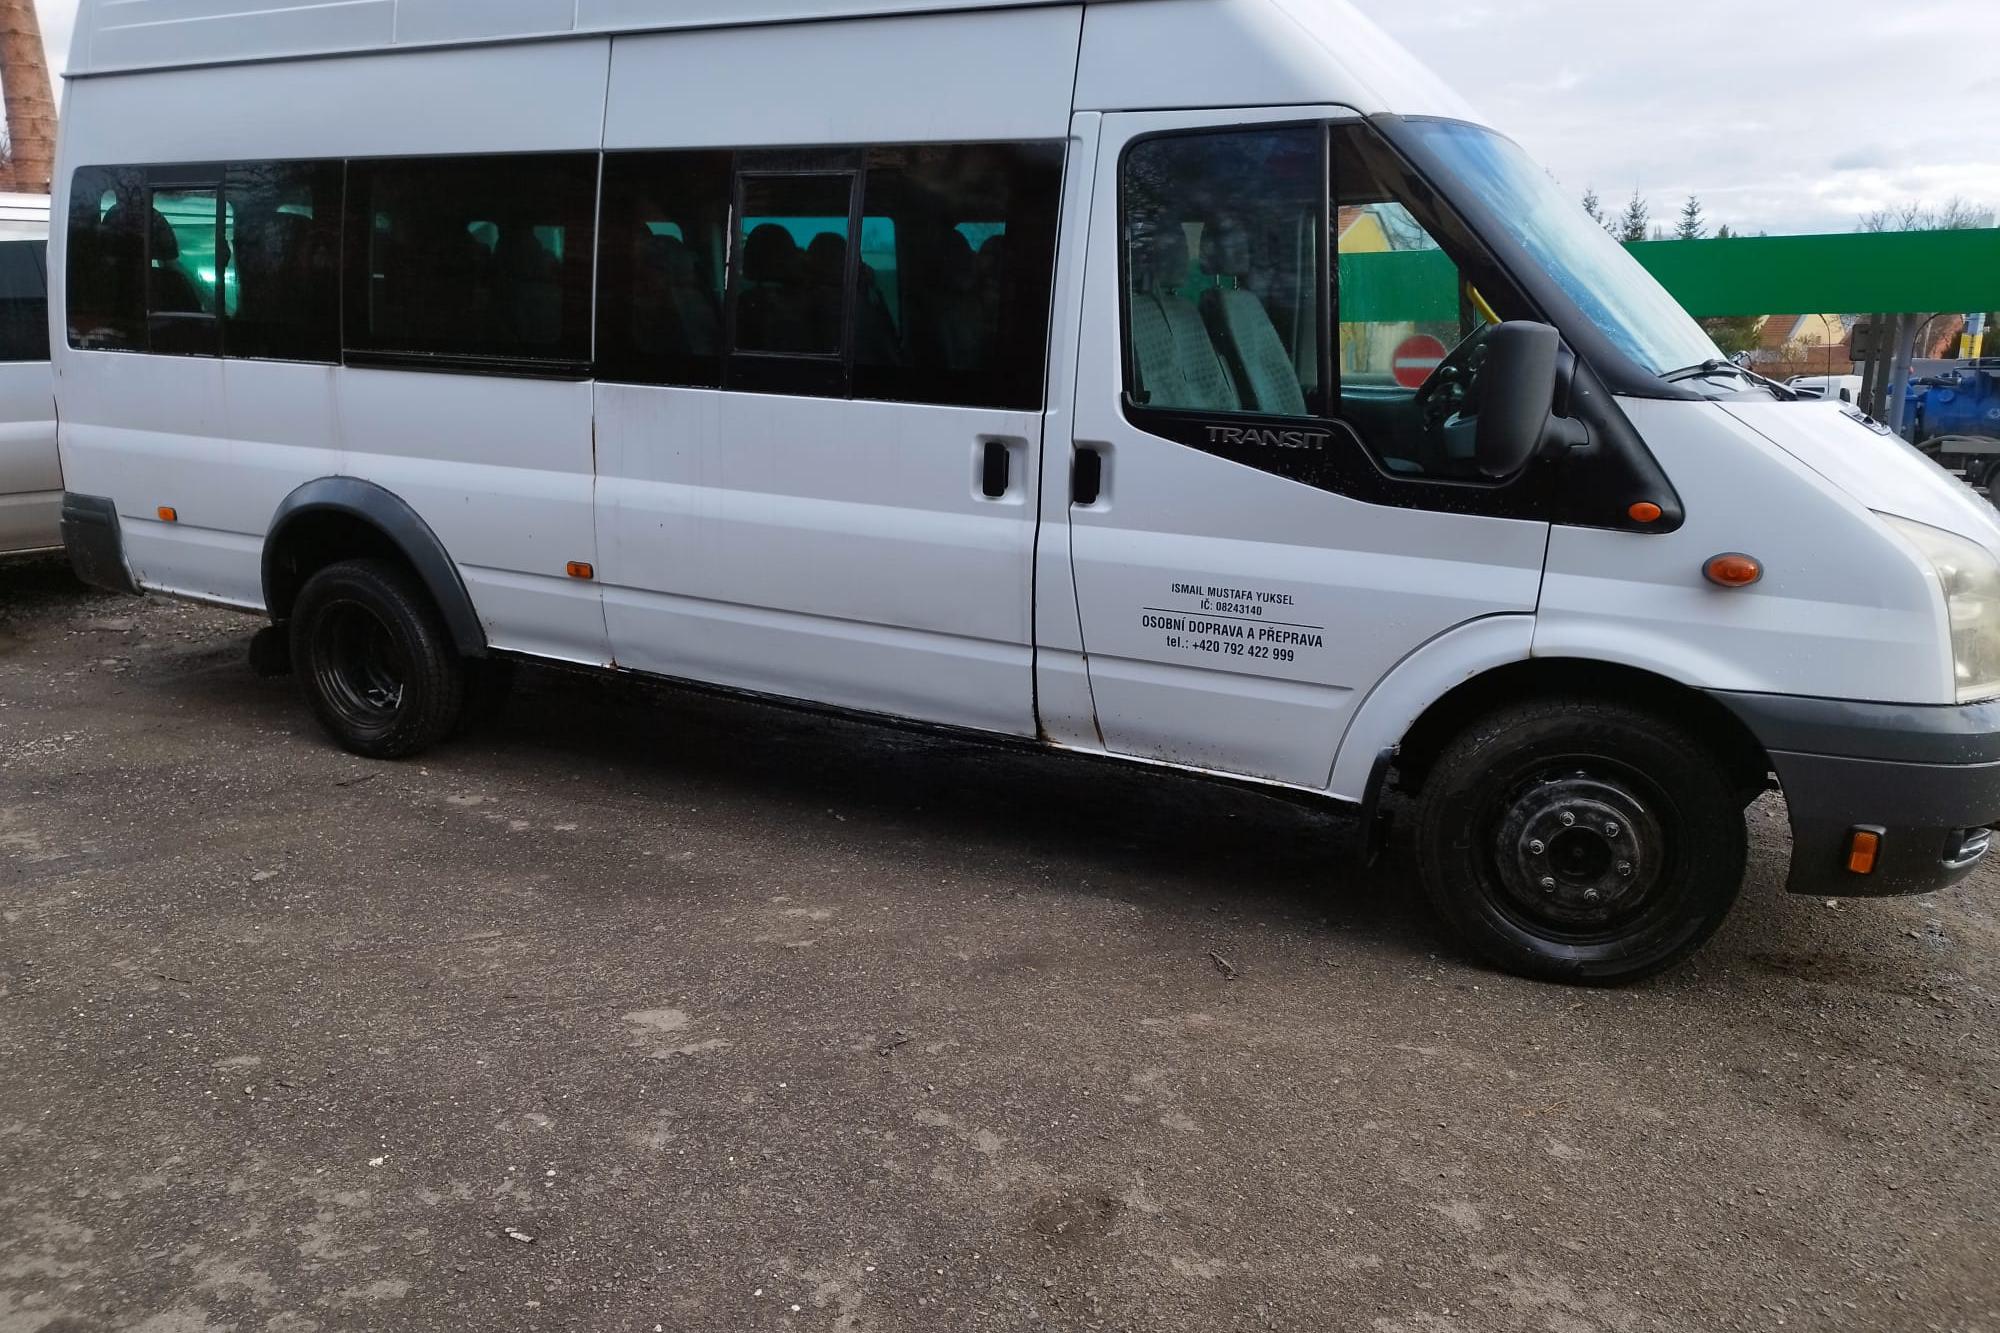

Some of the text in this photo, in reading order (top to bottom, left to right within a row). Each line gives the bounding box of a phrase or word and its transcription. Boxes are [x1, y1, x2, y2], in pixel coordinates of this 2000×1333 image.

[1205, 426, 1331, 450] TRANSIT
[1171, 583, 1295, 606] ISMAIL MUSTAFA YUKSEL
[1200, 598, 1262, 616] IČ: 08243140
[1142, 615, 1323, 648] OSOBNÍ DOPRAVA A PŘEPRAVA
[1166, 635, 1294, 662] tel.: +420 792 422 999
